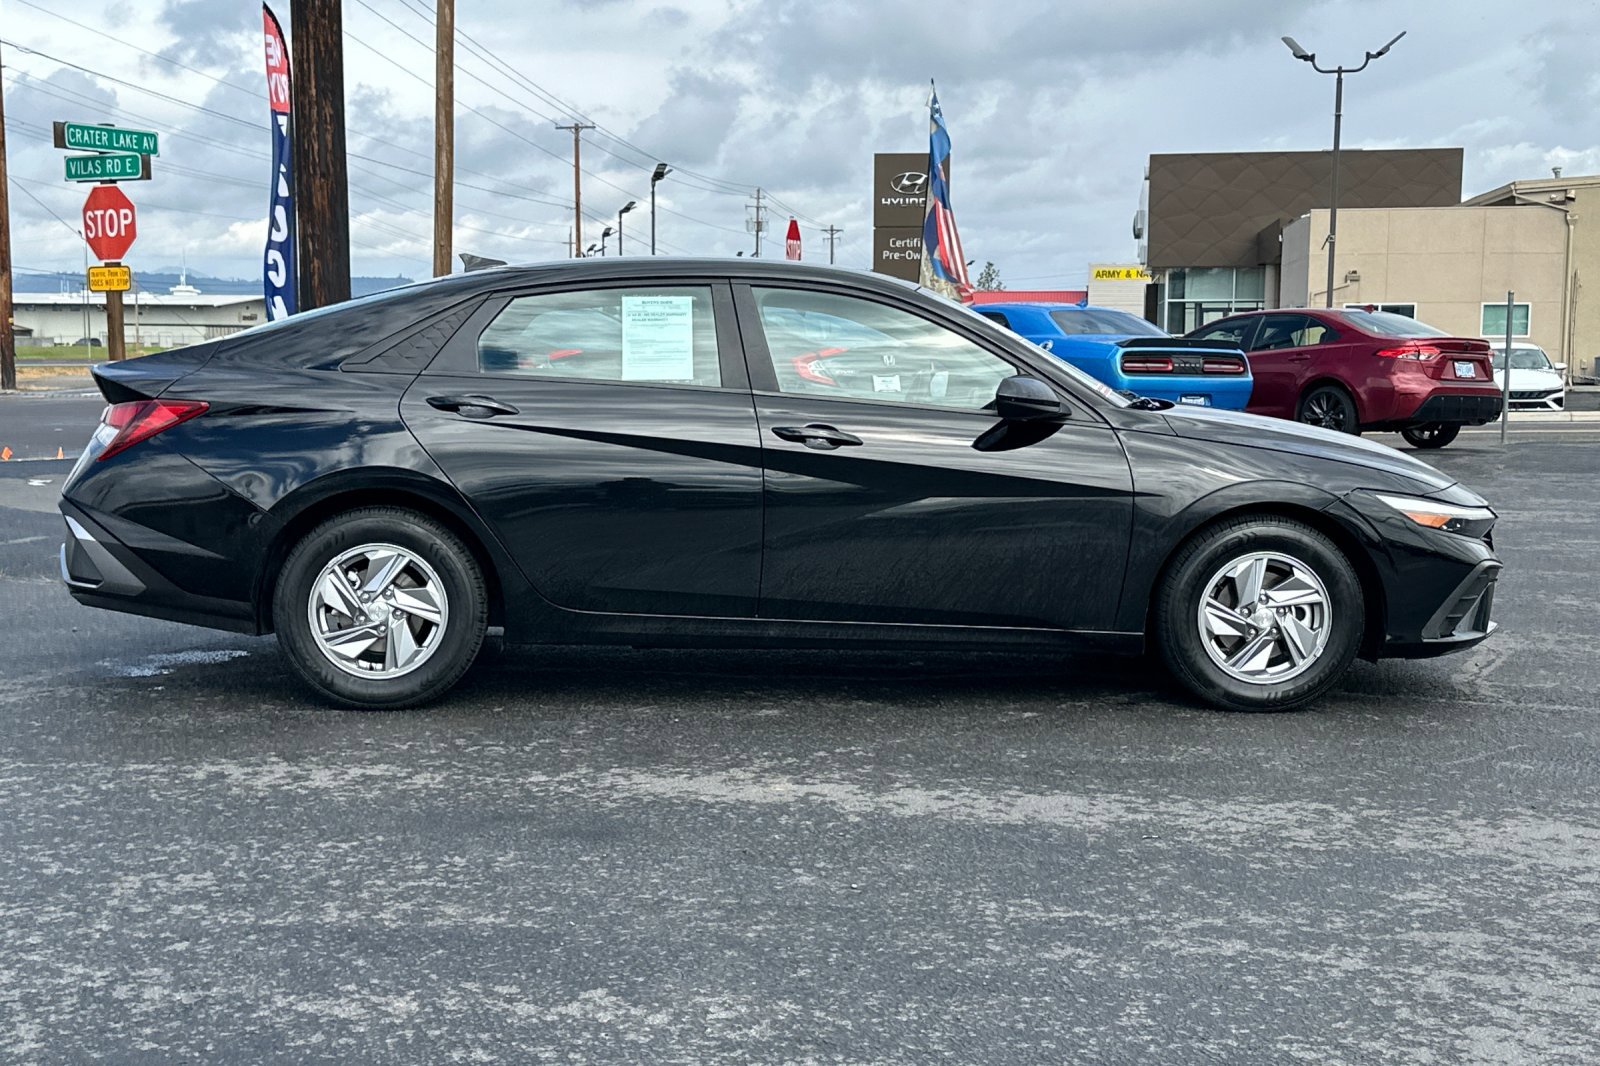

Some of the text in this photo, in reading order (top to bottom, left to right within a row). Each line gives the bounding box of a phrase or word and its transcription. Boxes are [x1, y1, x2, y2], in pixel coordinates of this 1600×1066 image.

[68, 127, 155, 151] CRATER LAKE AV
[69, 159, 102, 176] VILAS
[106, 158, 121, 174] RD
[881, 197, 926, 207] HYUND
[85, 208, 133, 239] STOP
[889, 237, 921, 248] Certifi
[882, 250, 921, 260] Pre-Ow
[1095, 269, 1121, 279] ARMY
[1125, 269, 1132, 279] &
